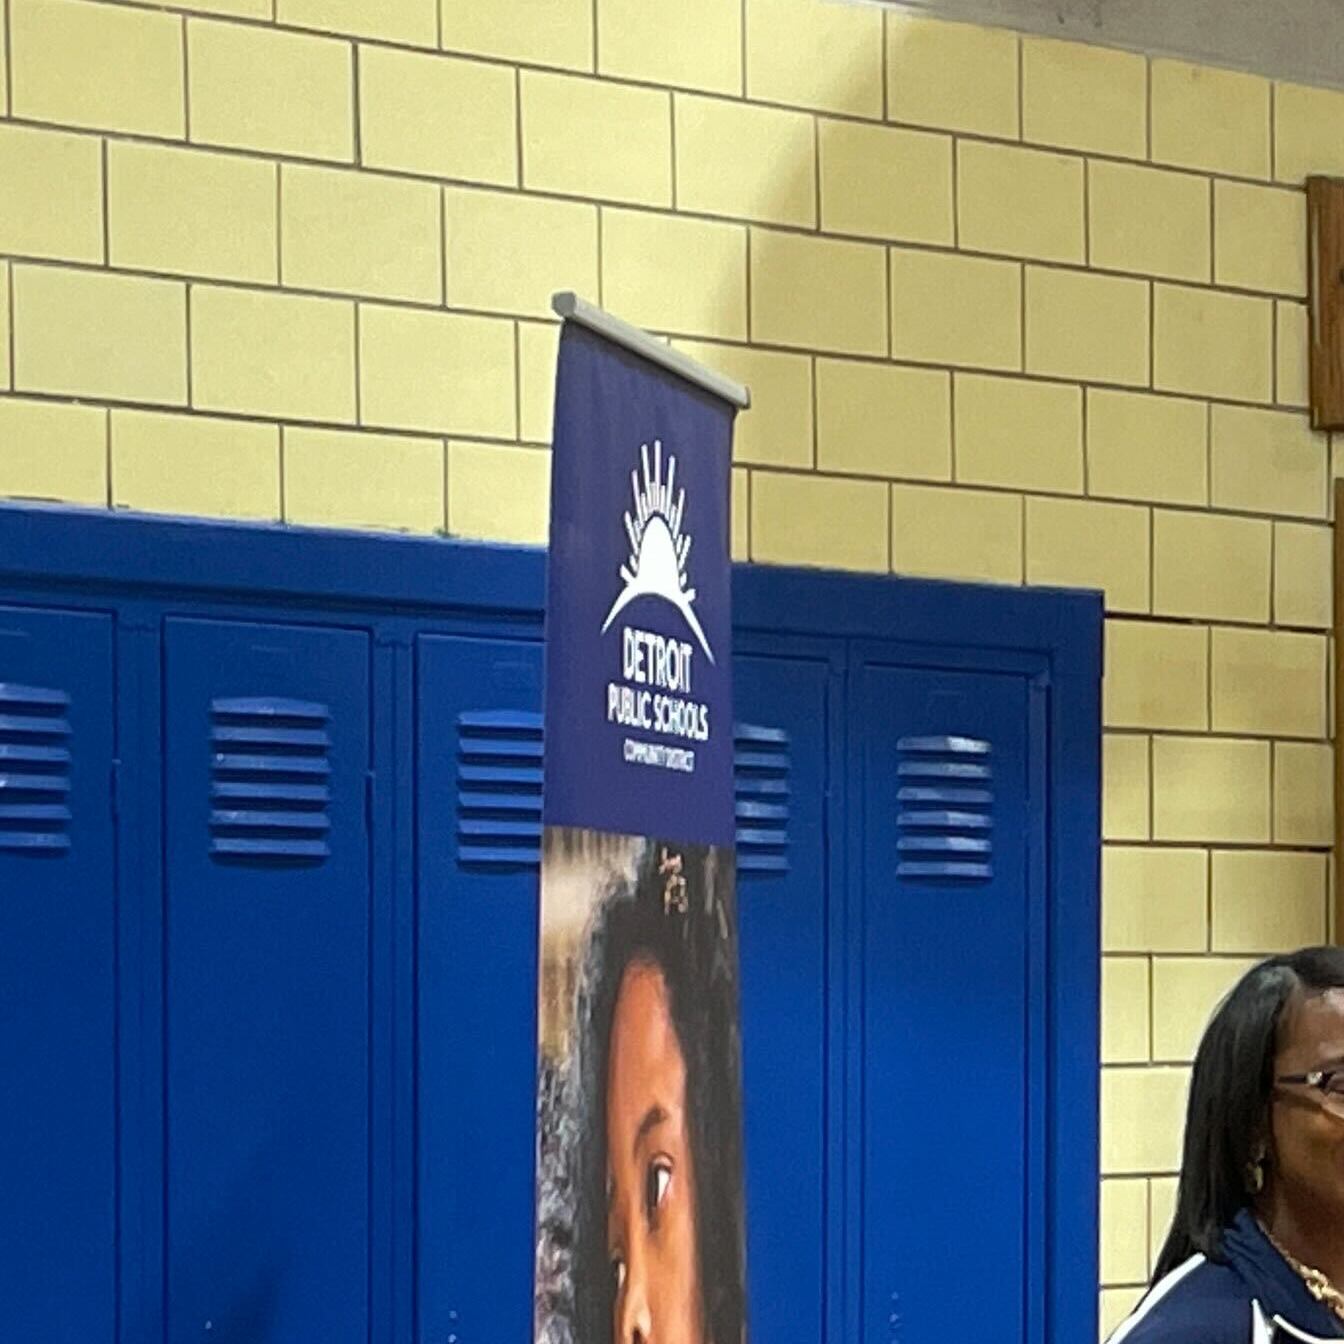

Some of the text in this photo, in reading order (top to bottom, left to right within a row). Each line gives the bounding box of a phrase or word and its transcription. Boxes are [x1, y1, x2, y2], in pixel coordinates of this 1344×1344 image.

[623, 626, 693, 694] DETROIT
[608, 682, 708, 741] PUBLIC SCHOOLS
